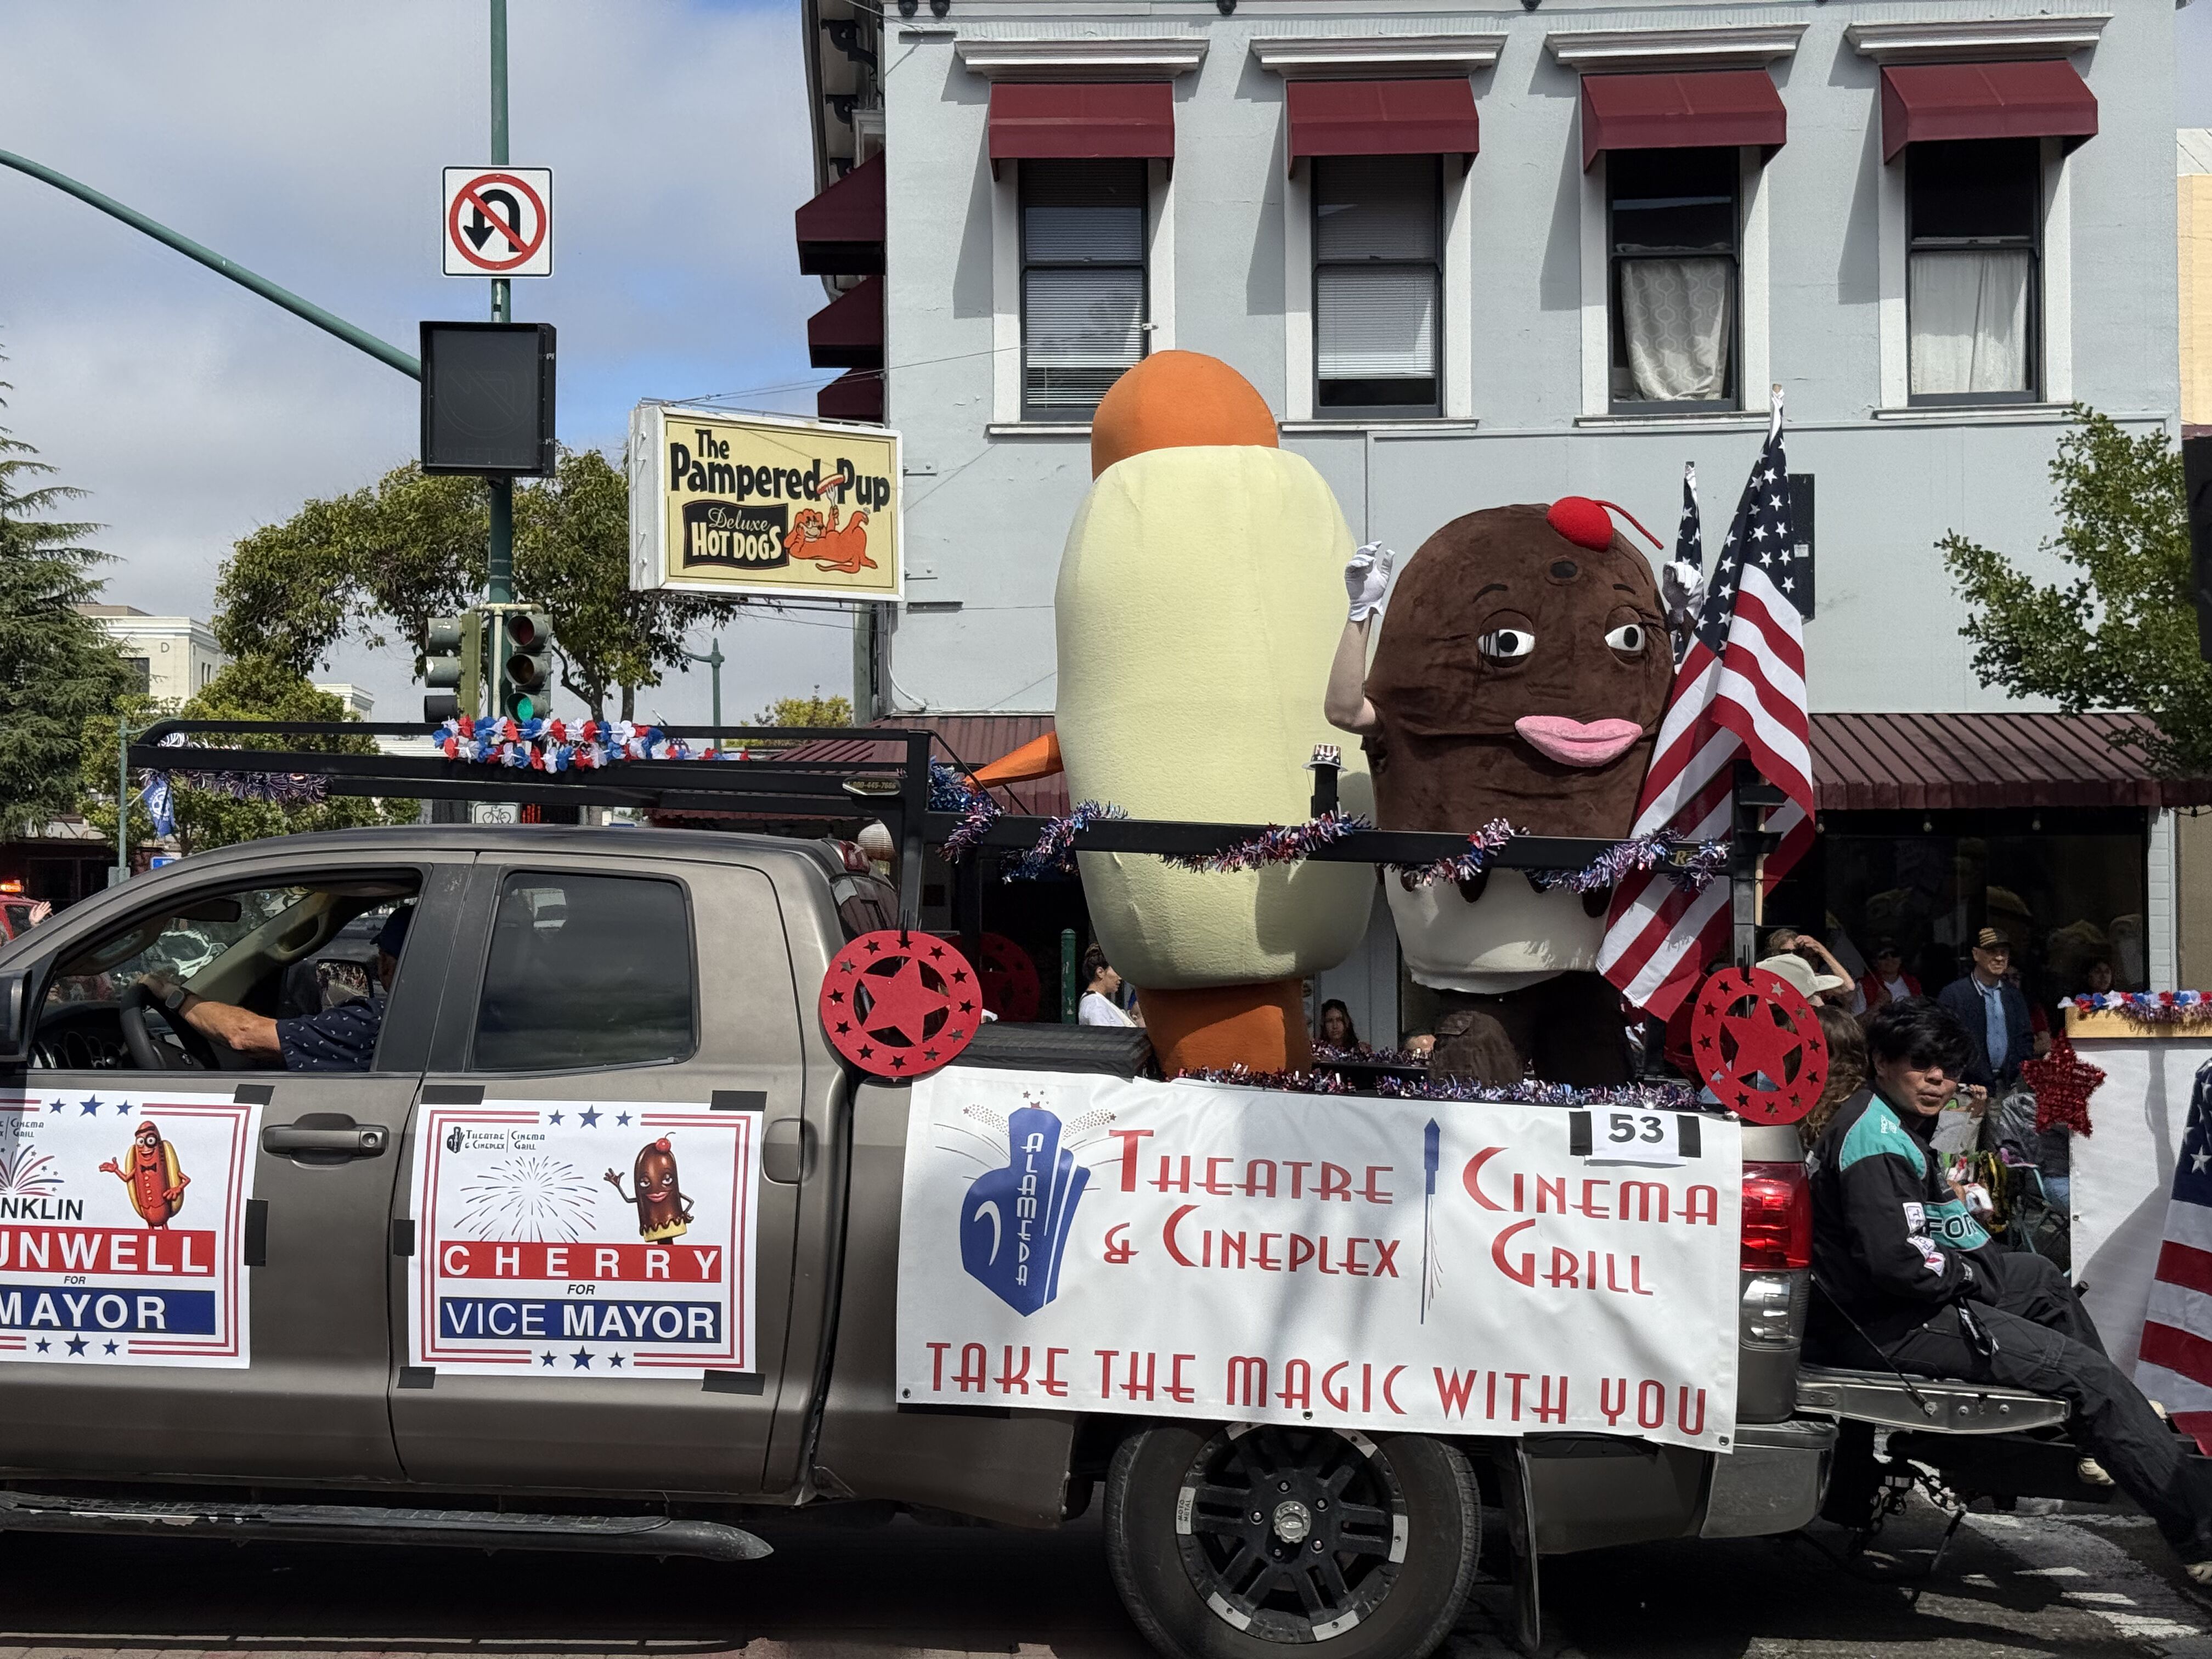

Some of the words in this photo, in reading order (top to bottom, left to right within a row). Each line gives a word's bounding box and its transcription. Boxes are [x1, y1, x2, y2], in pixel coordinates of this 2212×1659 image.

[695, 428, 730, 459] The
[670, 442, 821, 502] Pampered
[836, 458, 890, 512] Pup
[708, 506, 771, 532] Deluxe
[691, 521, 731, 557] HOT
[732, 523, 782, 562] DOGS
[1607, 1114, 1665, 1144] 53
[1108, 1129, 1394, 1205] THEATRE
[1462, 1146, 1718, 1226] CINEMA
[1015, 1132, 1045, 1287] ALAMEDA
[1103, 1222, 1139, 1265] &
[1162, 1204, 1401, 1278] CINEPLEX
[1491, 1218, 1654, 1296] GRILL
[63, 1275, 87, 1285] FOR
[443, 1244, 719, 1280] CHERRY
[567, 1284, 596, 1296] FOR
[0, 1291, 167, 1330] MAYOR
[445, 1301, 547, 1336] VICE
[562, 1304, 715, 1340] MAYOR
[926, 1342, 1070, 1397] TAKE
[1094, 1350, 1196, 1403] THE
[1226, 1356, 1409, 1415] MAGIC
[1432, 1365, 1569, 1425] WITH
[1600, 1377, 1707, 1436] YOU
